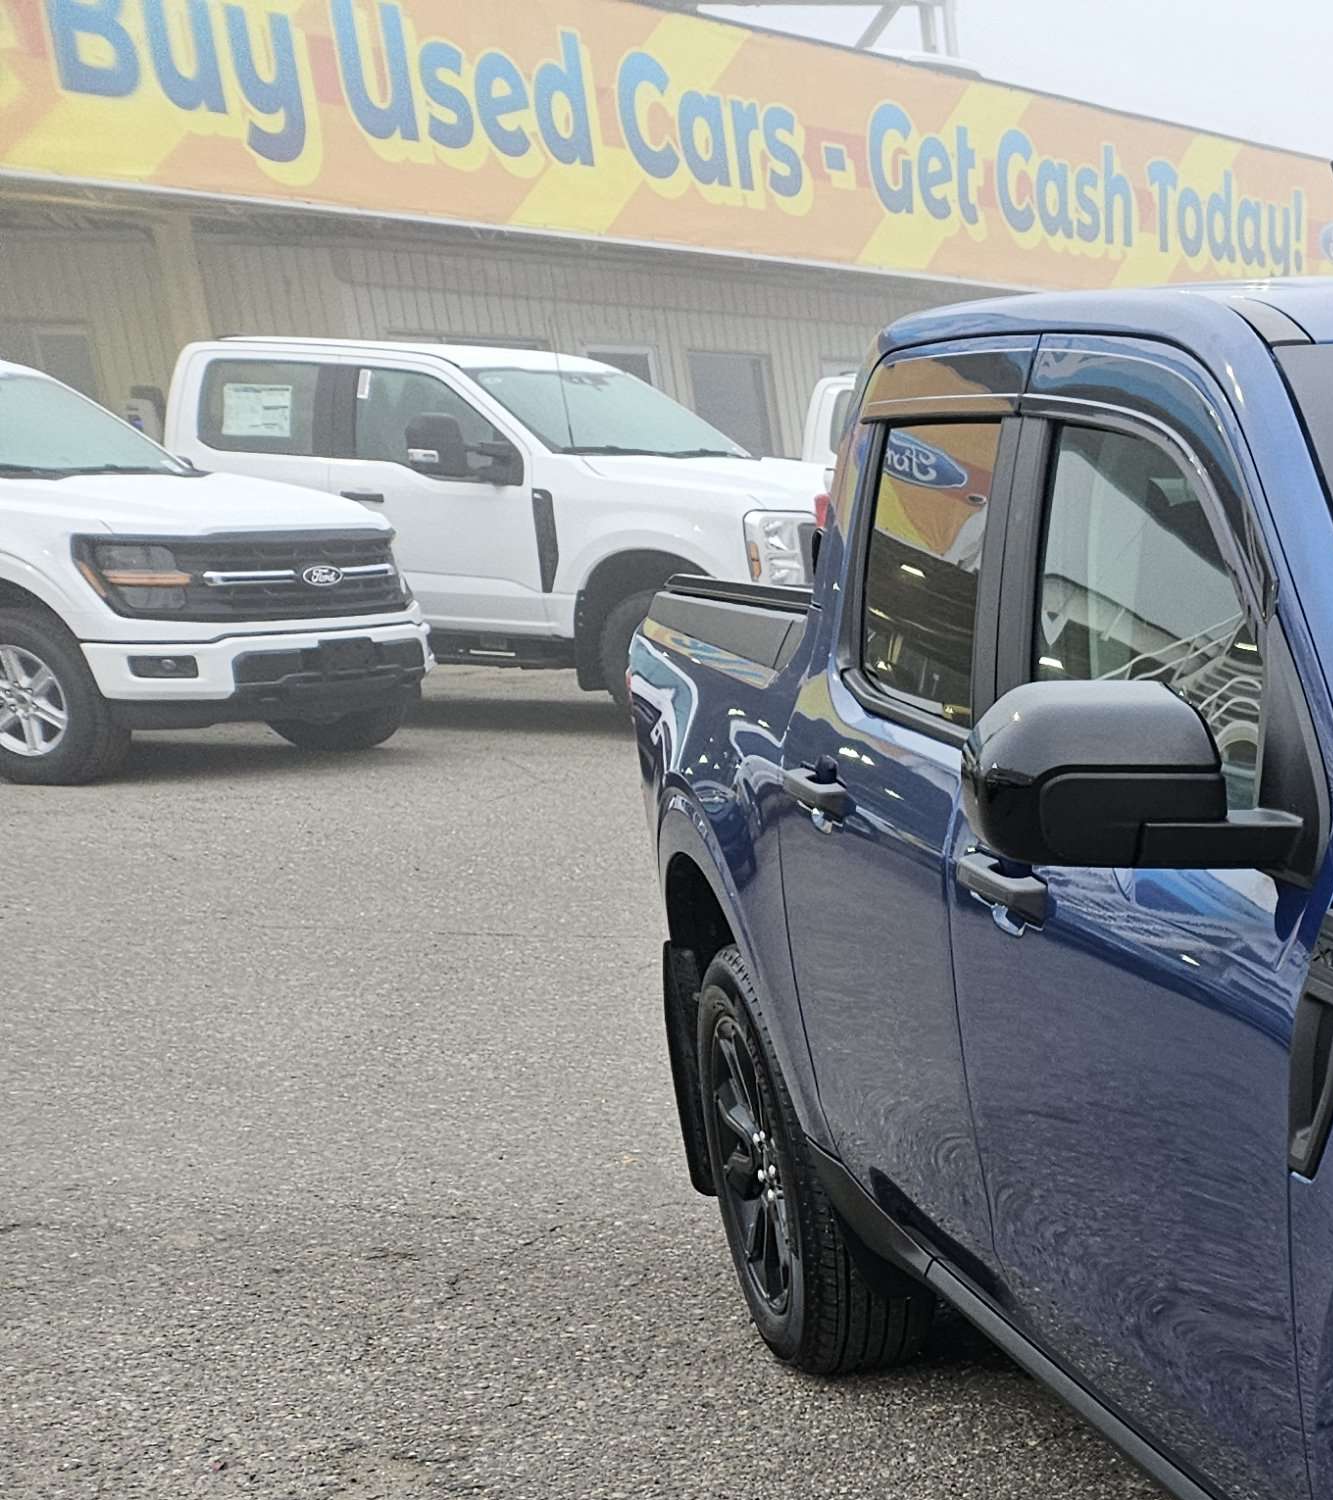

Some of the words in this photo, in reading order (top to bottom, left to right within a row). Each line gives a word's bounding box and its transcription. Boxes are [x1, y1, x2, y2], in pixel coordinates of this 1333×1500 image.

[44, 0, 306, 162] Buy
[327, 0, 595, 167] Used
[618, 52, 803, 198] Cars
[868, 103, 979, 225] Get
[997, 129, 1133, 248] Cash
[1147, 160, 1304, 277] Today!
